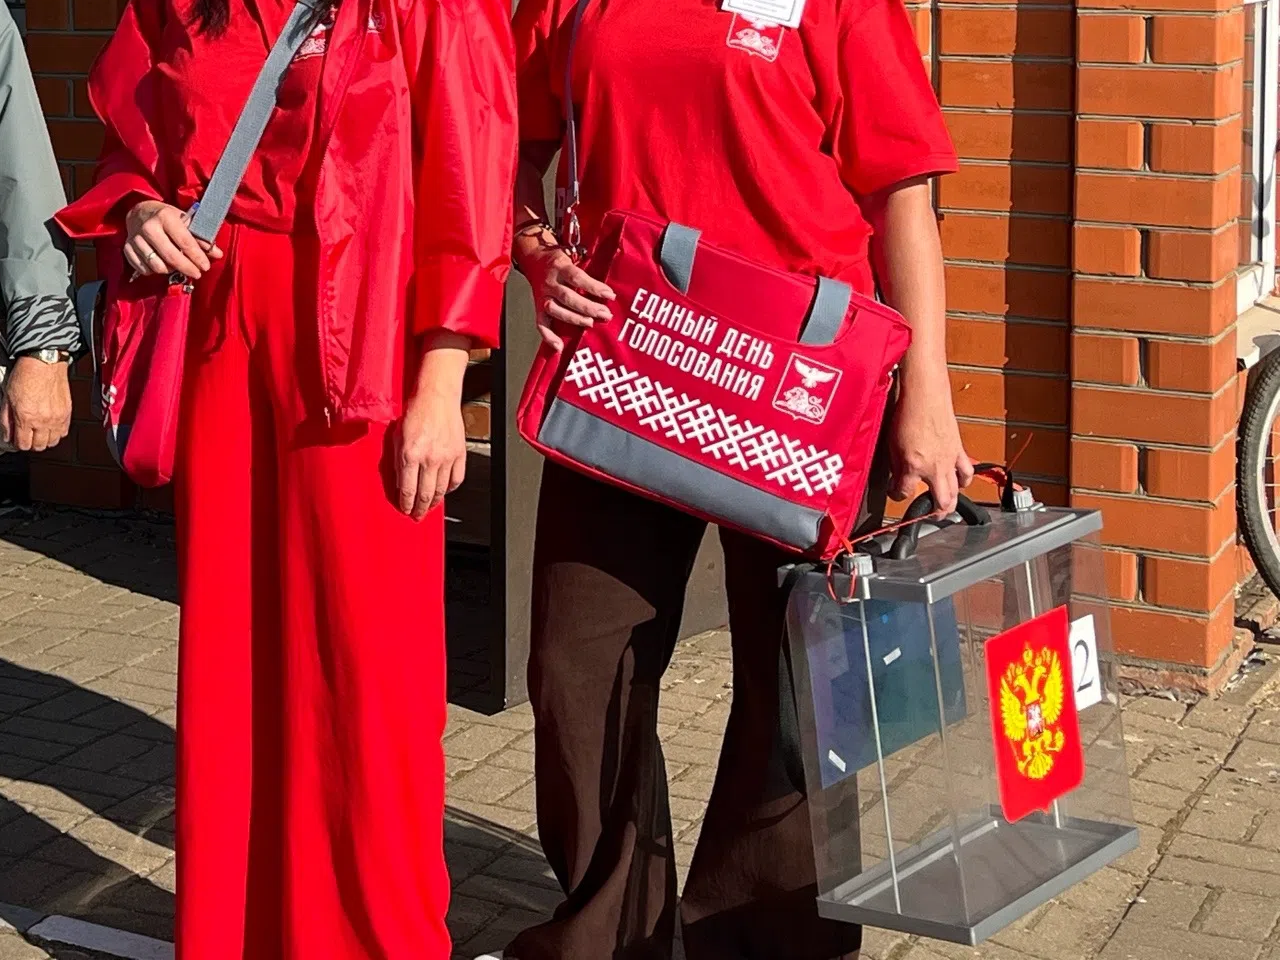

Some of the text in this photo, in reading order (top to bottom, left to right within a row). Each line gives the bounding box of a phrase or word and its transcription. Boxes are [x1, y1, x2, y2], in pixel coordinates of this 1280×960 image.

[617, 317, 765, 401] ГОЛОСОВАНИЯ
[630, 287, 775, 370] ЕДИНЫЙ ДЕНЬ
[1072, 638, 1095, 693] 2
